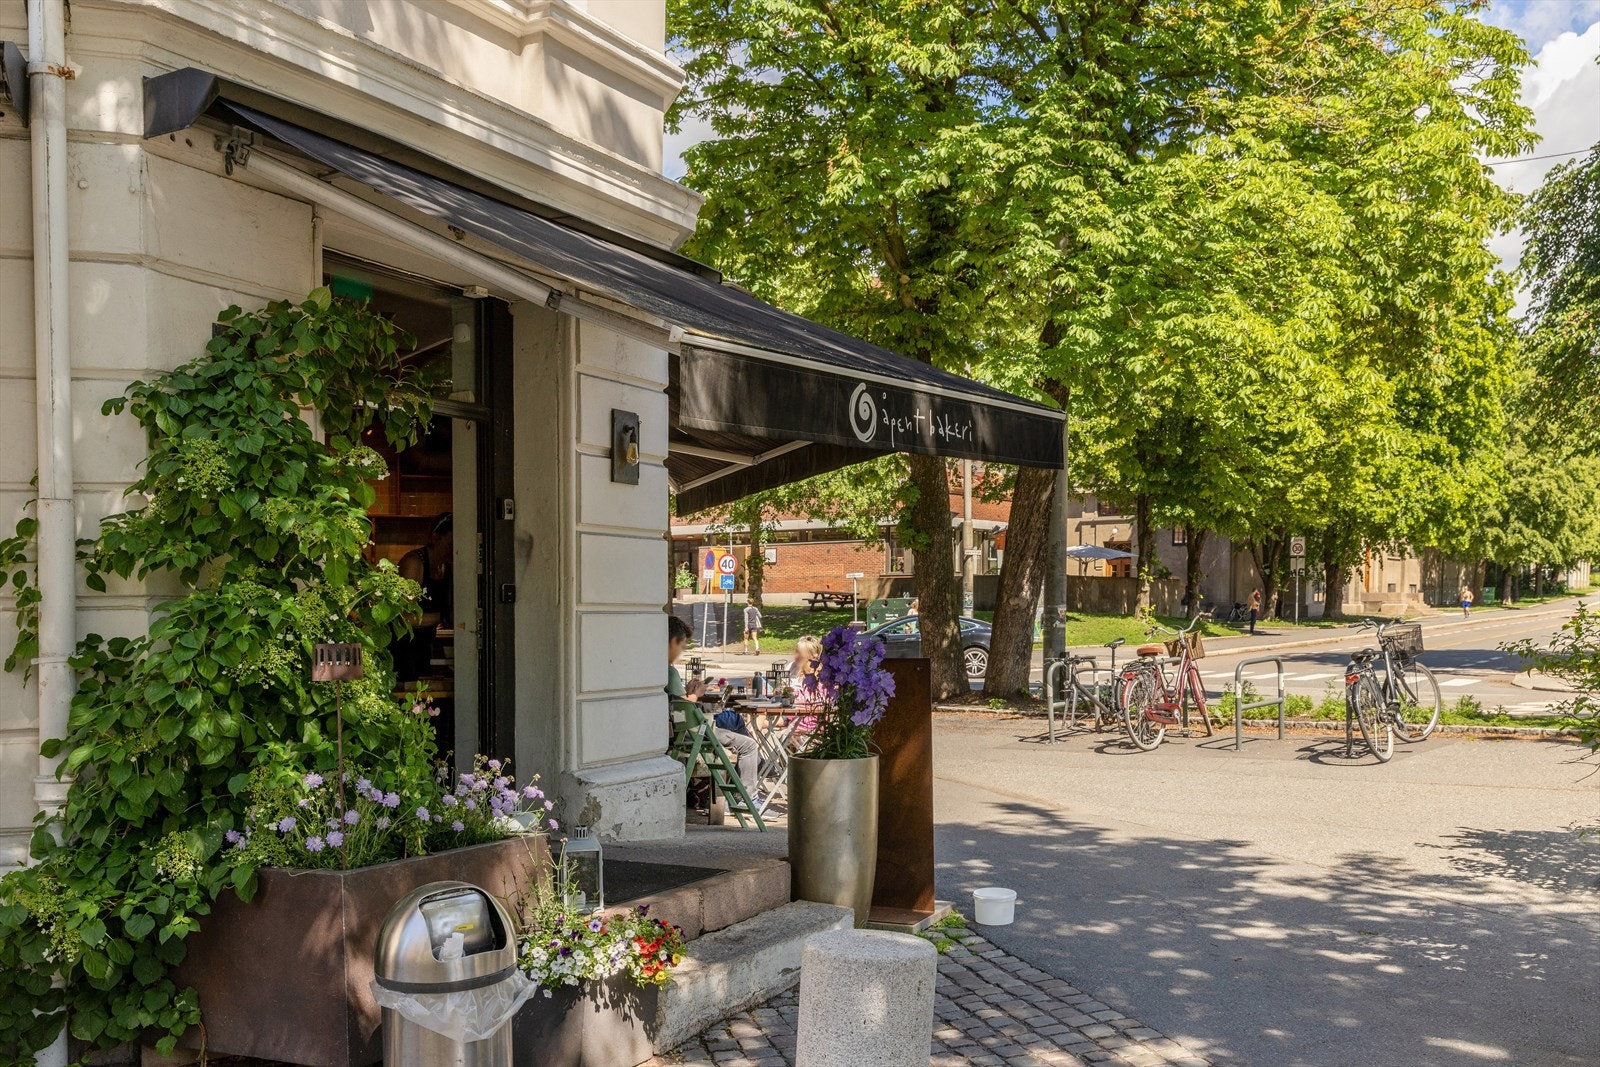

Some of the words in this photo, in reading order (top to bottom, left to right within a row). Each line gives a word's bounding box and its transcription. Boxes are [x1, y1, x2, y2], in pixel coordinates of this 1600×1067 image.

[882, 392, 926, 449] åpent
[929, 408, 972, 443] bakeri
[721, 559, 735, 570] 40
